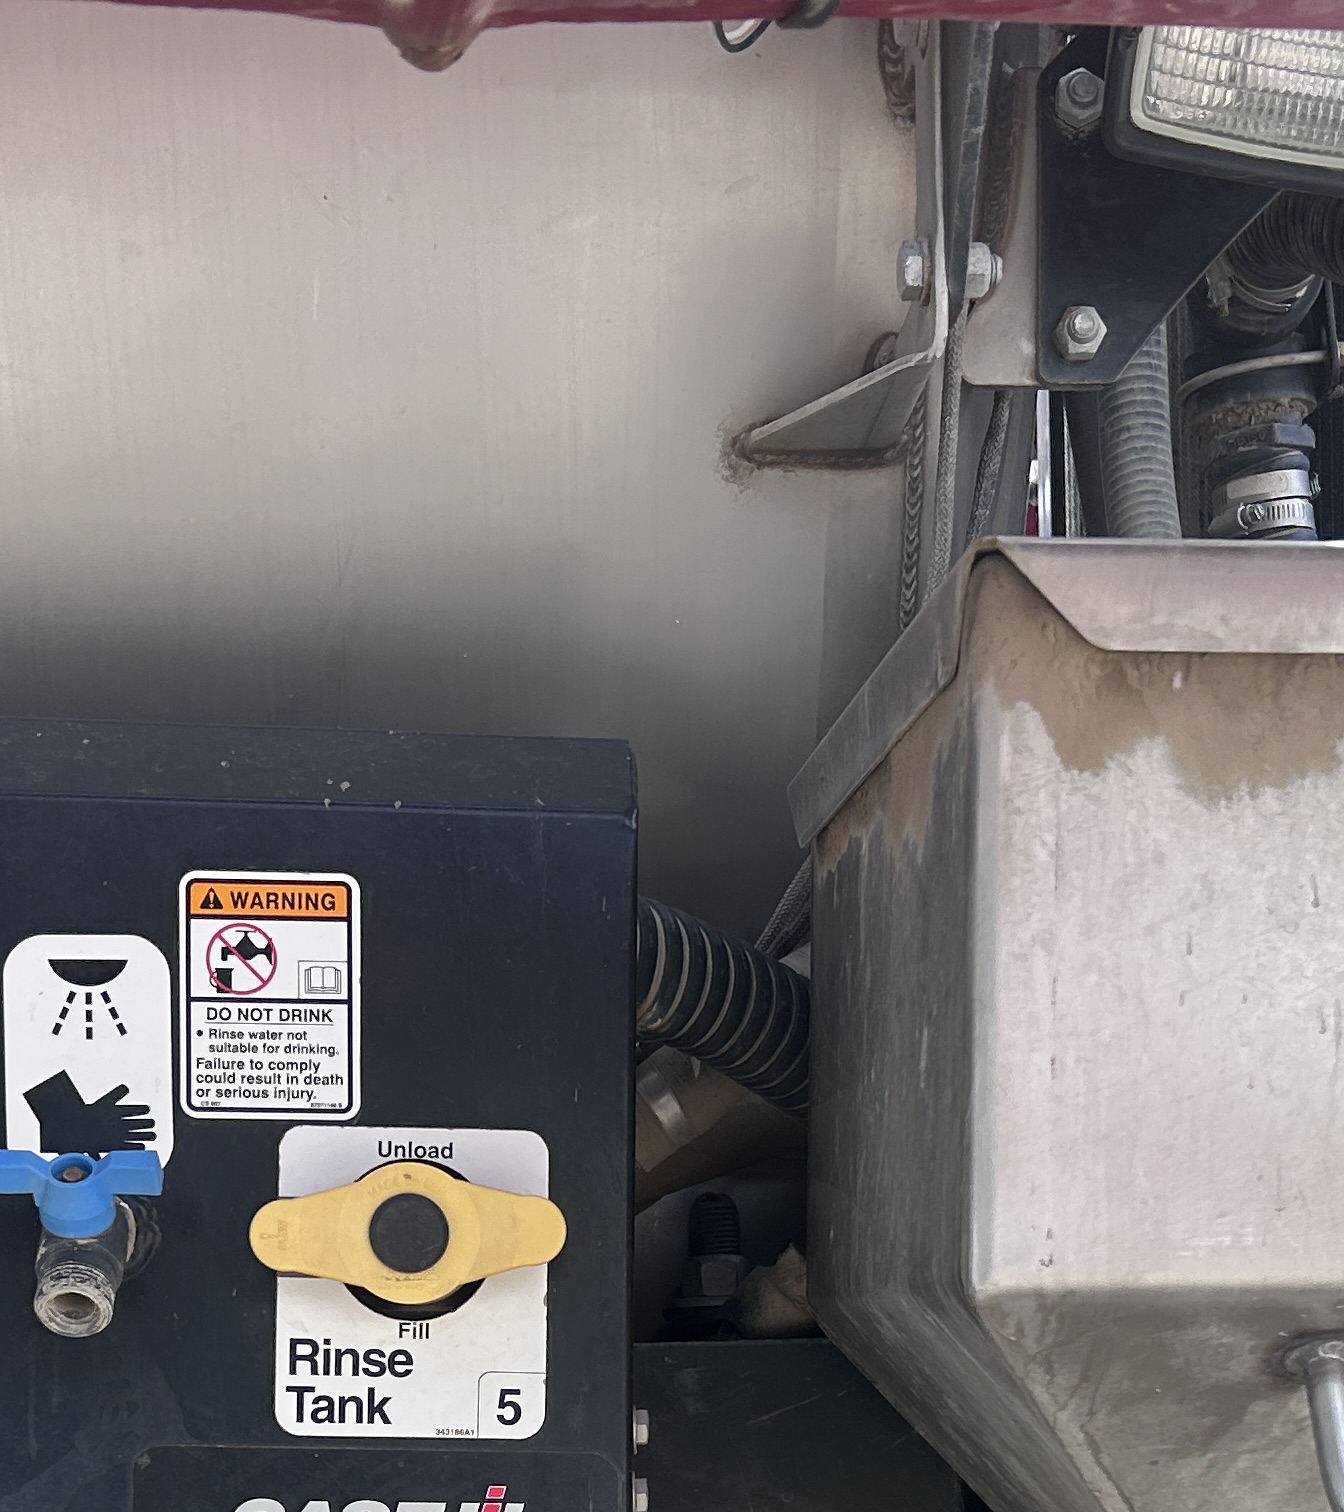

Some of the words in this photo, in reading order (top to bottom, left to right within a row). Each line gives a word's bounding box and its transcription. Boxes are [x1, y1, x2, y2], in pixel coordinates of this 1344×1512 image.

[230, 890, 336, 911] WARNING
[206, 1007, 231, 1021] DO
[238, 1008, 273, 1022] NOT
[279, 1008, 333, 1023] DRINK
[209, 1028, 244, 1040] Rinse
[248, 1030, 283, 1040] water
[287, 1030, 307, 1041] not
[209, 1042, 258, 1054] suitable
[262, 1043, 280, 1055] for
[284, 1043, 339, 1058] drinking.
[197, 1058, 245, 1070] Failure
[249, 1060, 263, 1071] to
[268, 1059, 320, 1074] comply
[196, 1072, 235, 1084] could
[241, 1073, 281, 1085] result
[286, 1073, 299, 1085] in
[304, 1074, 344, 1086] death
[196, 1088, 210, 1098] or
[215, 1087, 269, 1099] serious
[274, 1087, 317, 1102] injury.
[377, 1140, 454, 1160] Unload
[398, 1322, 430, 1340] Fill
[288, 1337, 414, 1378] Rinse
[285, 1385, 392, 1425] Tank
[496, 1388, 522, 1426] 5
